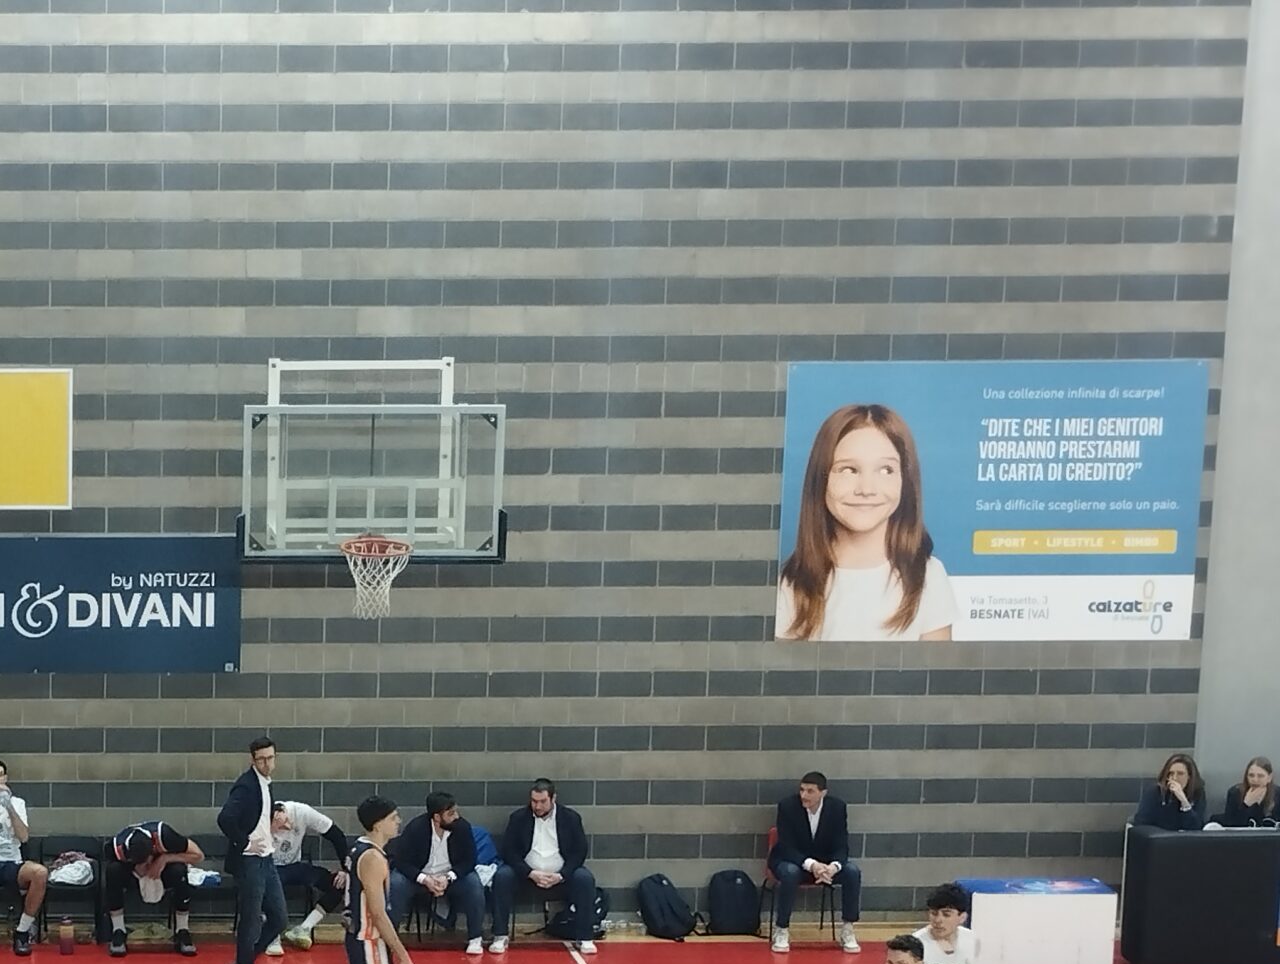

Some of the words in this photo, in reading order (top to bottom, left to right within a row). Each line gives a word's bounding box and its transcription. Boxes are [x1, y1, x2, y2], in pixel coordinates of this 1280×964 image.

[983, 388, 1006, 399] Una
[1008, 388, 1064, 399] collezione
[1068, 387, 1106, 399] infinita
[1109, 387, 1120, 399] di
[1122, 387, 1165, 400] scarpe!
[1023, 418, 1052, 437] CHE
[1054, 418, 1060, 437] I
[1063, 417, 1095, 437] MIEI
[1097, 416, 1164, 436] GENITORI
[979, 440, 1056, 459] VORRANNO
[1059, 440, 1141, 459] PRESTARMI
[977, 463, 995, 482] LA
[998, 463, 1044, 481] CARTA
[1047, 463, 1063, 481] DI
[975, 499, 1001, 511] Sarà
[1004, 499, 1045, 511] difficile
[1048, 499, 1106, 513] sceglierne
[1109, 499, 1133, 511] solo
[1135, 501, 1150, 510] un
[1153, 499, 1180, 512] paio.
[990, 536, 1026, 548] SPORT
[1046, 536, 1104, 548] LIFESTYLE
[111, 573, 133, 590] by
[139, 572, 215, 588] NATUZZI
[970, 596, 984, 605] Via
[1088, 599, 1174, 613] calzature
[11, 582, 65, 638] &
[67, 592, 215, 628] DIVANI
[970, 609, 1024, 619] BESNATE
[1027, 608, 1049, 620] (VA)
